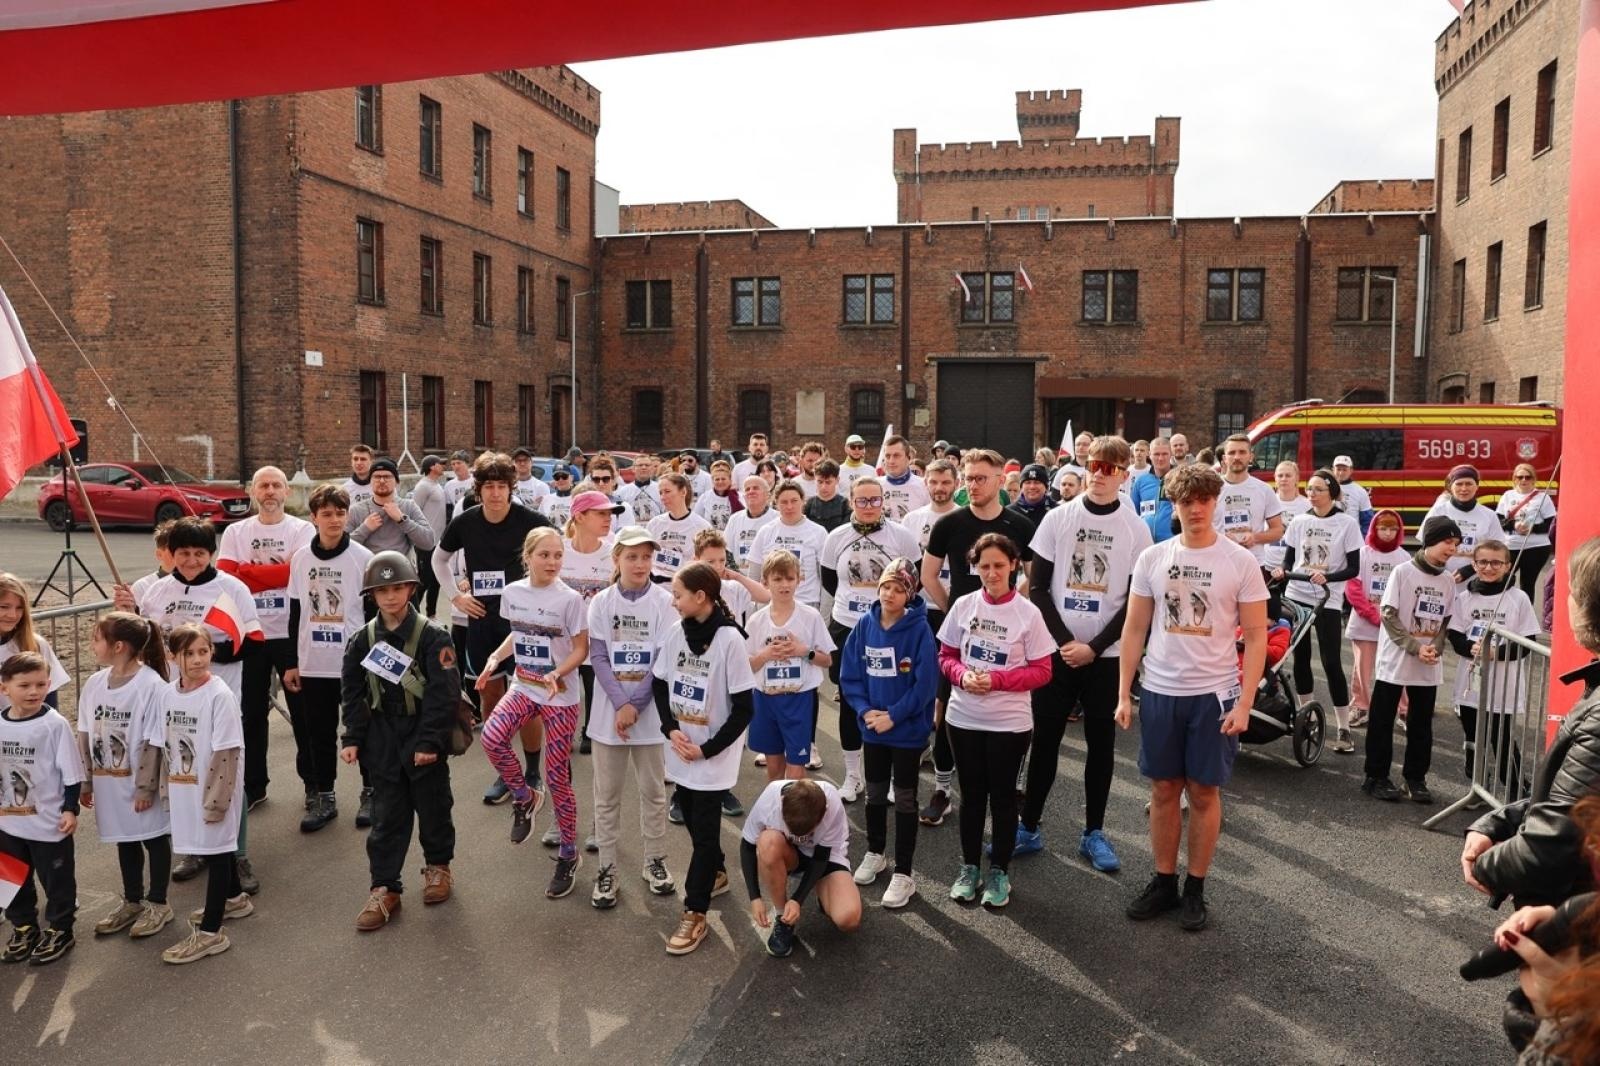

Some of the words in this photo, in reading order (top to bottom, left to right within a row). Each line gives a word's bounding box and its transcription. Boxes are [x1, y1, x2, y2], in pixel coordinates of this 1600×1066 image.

[1418, 439, 1453, 458] 569
[1457, 443, 1464, 455] S
[1468, 439, 1491, 458] 33
[1182, 570, 1212, 579] WILCZYM
[480, 579, 497, 589] 127
[262, 598, 276, 608] 13
[1074, 600, 1089, 610] 25
[1425, 603, 1441, 613] 105
[322, 632, 333, 641] 11
[525, 645, 538, 657] 51
[980, 649, 996, 662] 35
[378, 655, 396, 670] 48
[625, 652, 641, 663] 69
[869, 658, 883, 669] 36
[777, 667, 790, 678] 41
[681, 685, 695, 697] 89
[2, 747, 35, 756] WILCZYM
